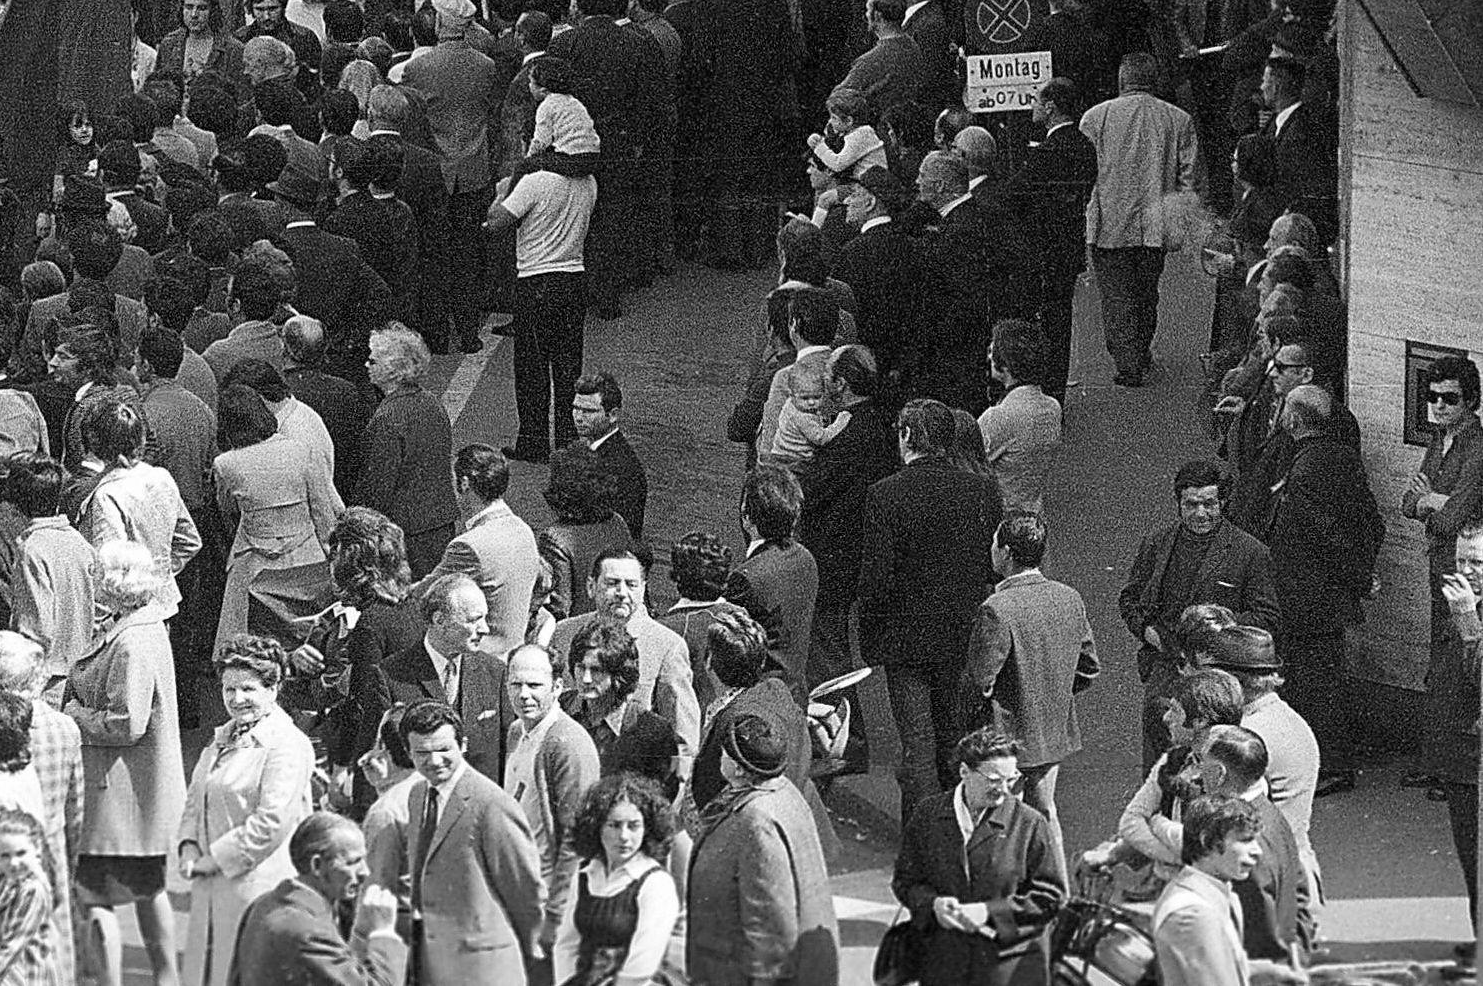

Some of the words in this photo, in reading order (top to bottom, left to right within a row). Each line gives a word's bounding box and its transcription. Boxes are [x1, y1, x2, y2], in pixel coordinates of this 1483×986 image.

[979, 58, 1040, 80] Montag
[978, 96, 995, 109] ab
[996, 90, 1016, 105] 07
